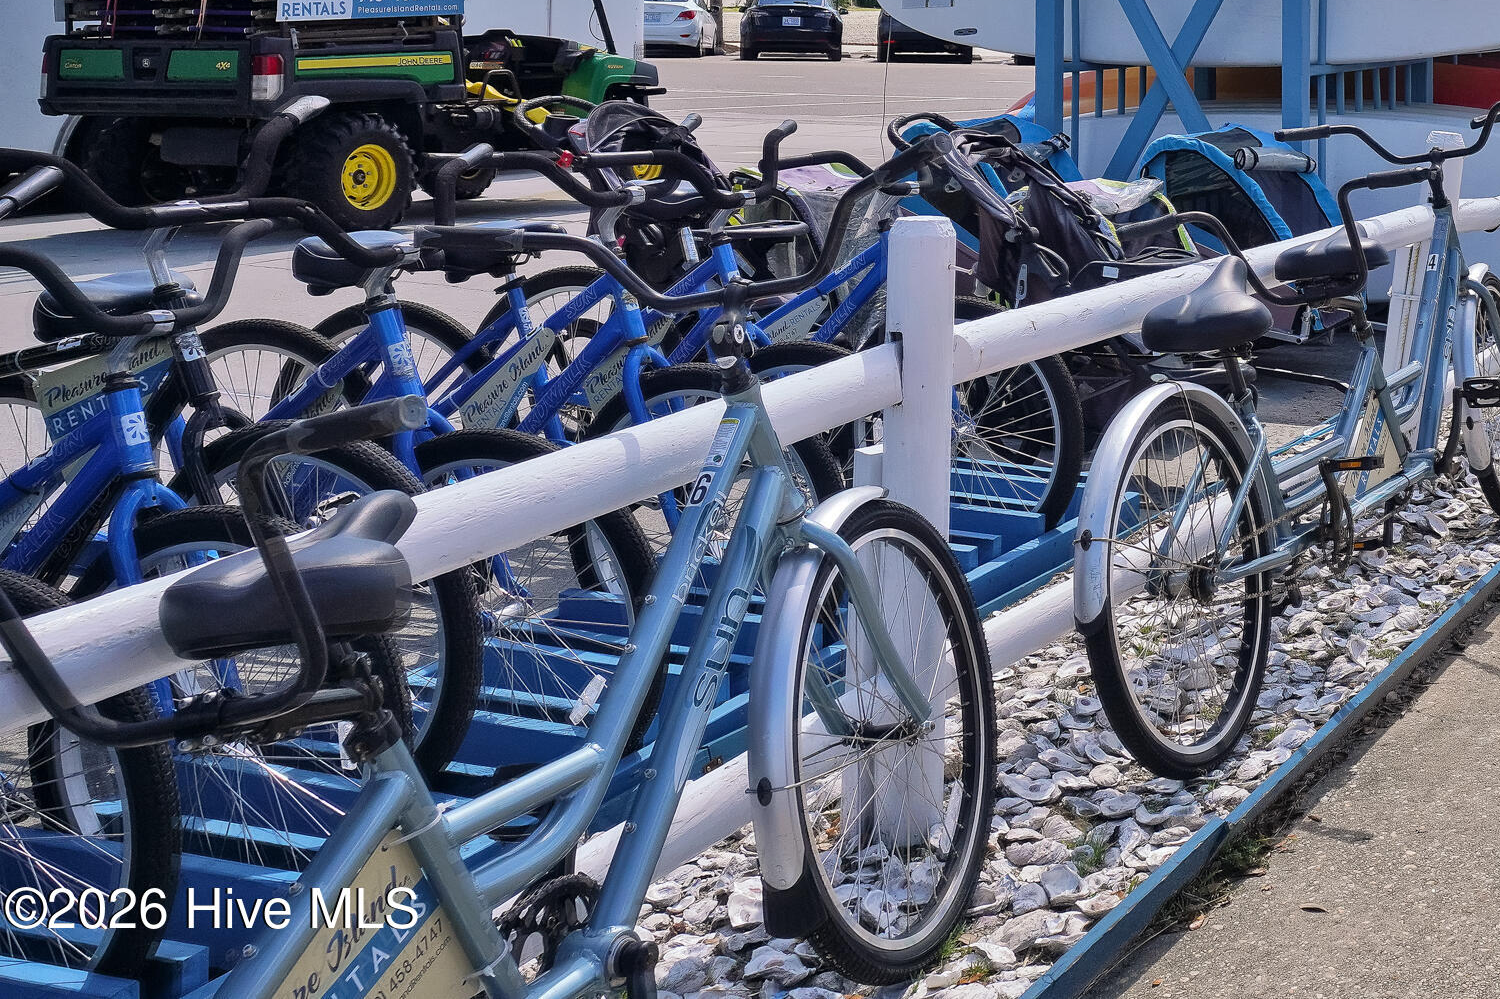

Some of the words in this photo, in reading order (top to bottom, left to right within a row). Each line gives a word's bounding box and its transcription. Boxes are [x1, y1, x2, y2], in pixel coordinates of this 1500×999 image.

[281, 1, 347, 17] RENTALS
[357, 4, 458, 14] PleasureIslandRentals.com
[397, 57, 418, 66] JOHN
[418, 56, 443, 65] DEERE
[1428, 255, 1436, 269] 4
[790, 303, 822, 325] RENTALS
[44, 372, 108, 407] Pleasure
[463, 380, 508, 423] Pleasure
[508, 339, 545, 381] Island
[690, 473, 711, 504] 6
[672, 490, 727, 605] brickell
[389, 918, 442, 992] 458-4747
